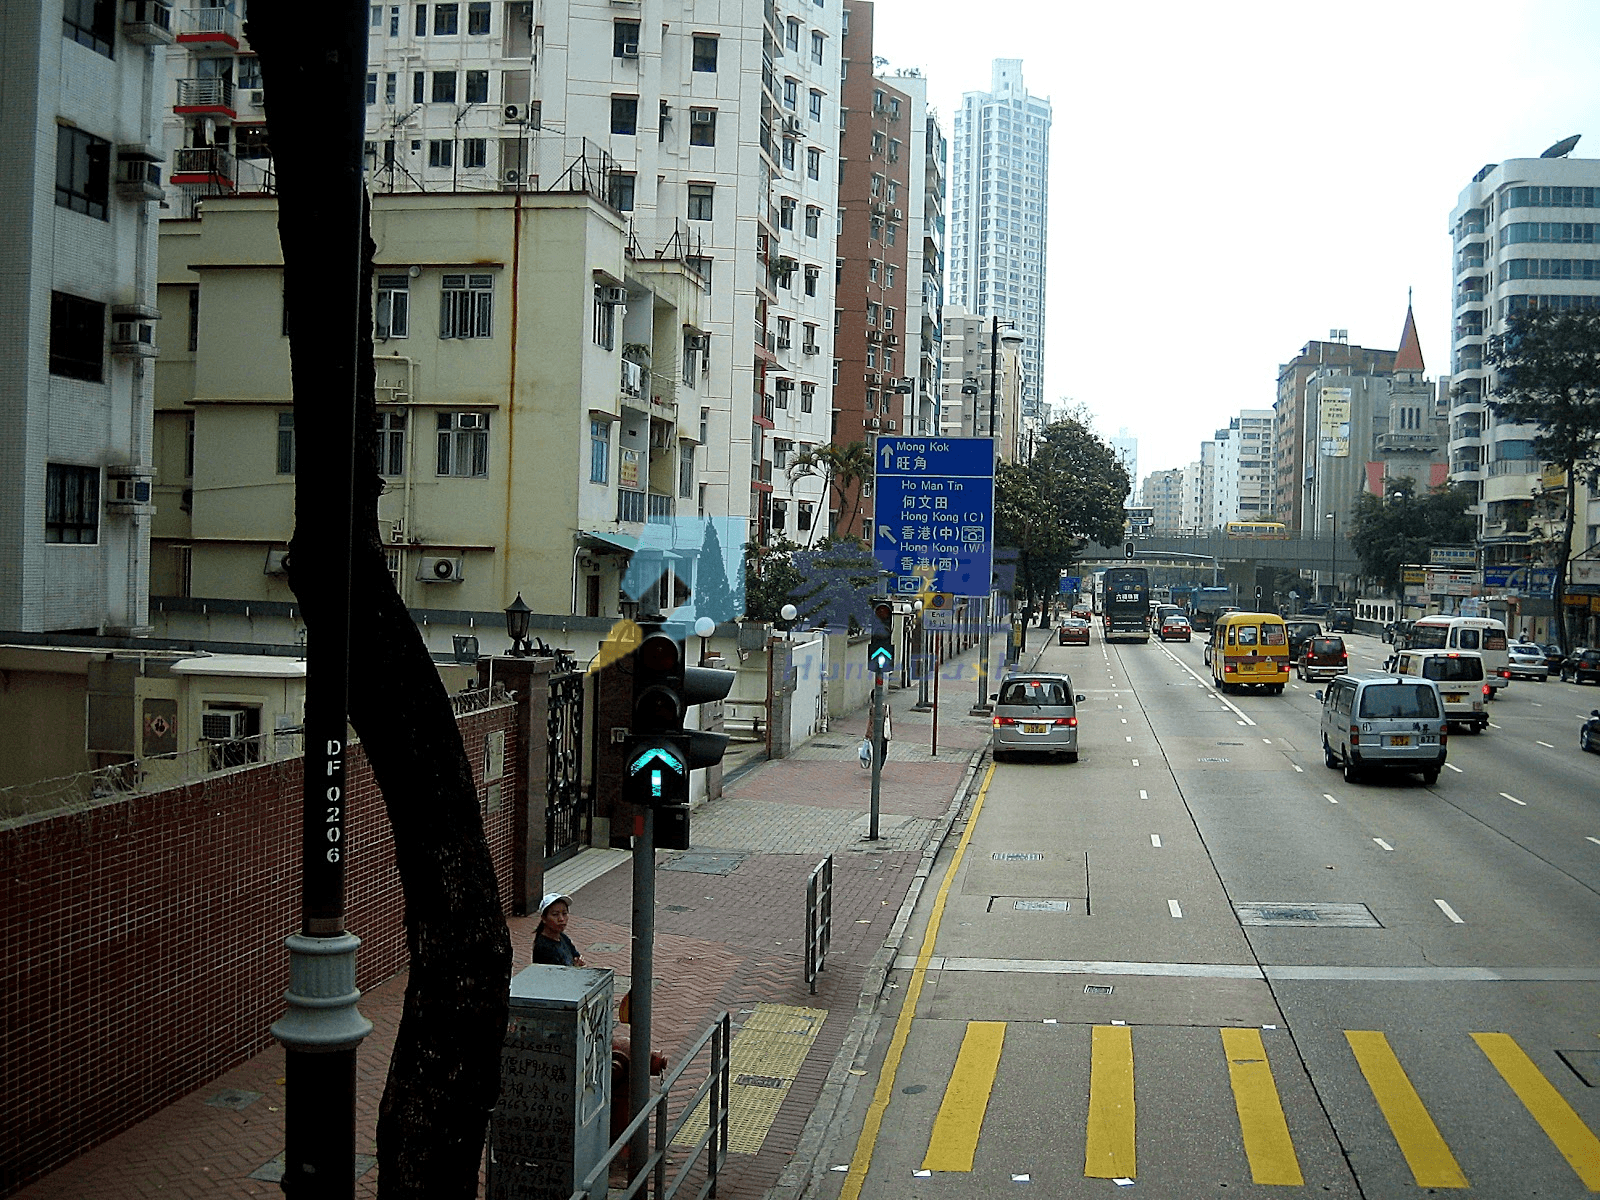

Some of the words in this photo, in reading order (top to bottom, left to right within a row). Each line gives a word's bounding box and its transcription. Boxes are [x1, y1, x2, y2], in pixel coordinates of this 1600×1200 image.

[896, 442, 925, 453] Mong
[930, 442, 950, 452] Kok
[896, 456, 927, 471] 旺角
[902, 480, 917, 490] Ho
[921, 480, 944, 491] Man
[947, 480, 963, 491] Tin
[902, 495, 948, 510] 何文田
[900, 511, 928, 523] Hong
[932, 512, 959, 523] Kong
[964, 512, 984, 522] (C)
[902, 526, 960, 541] 香港(中)
[900, 542, 928, 553] Hong
[932, 542, 959, 554] Kong
[964, 543, 986, 553] (W)
[900, 557, 959, 572] 香港(西)
[326, 740, 342, 776] DF
[326, 786, 341, 863] 0206
